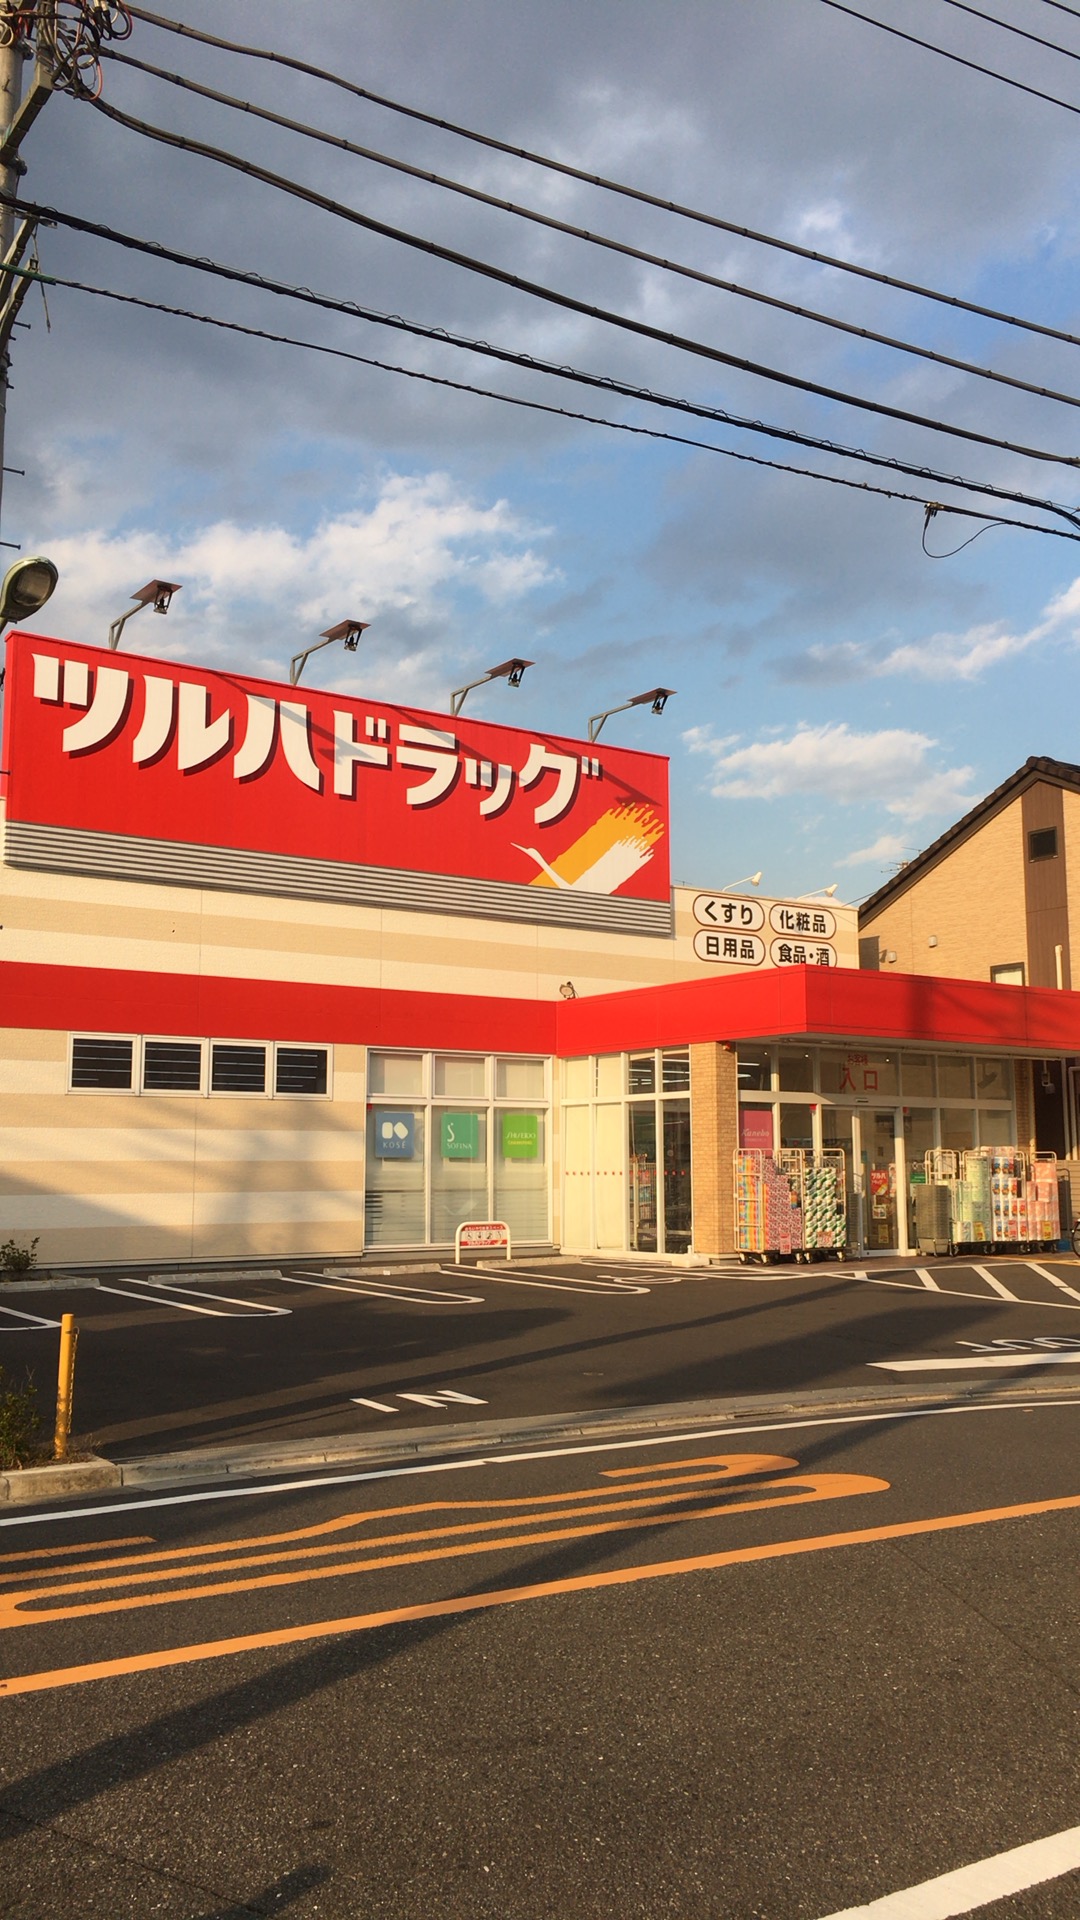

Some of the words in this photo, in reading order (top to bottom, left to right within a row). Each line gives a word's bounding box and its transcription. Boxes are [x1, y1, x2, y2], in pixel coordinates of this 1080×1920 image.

[32, 653, 600, 826] ツルハドラッグ
[704, 901, 753, 925] くすり
[779, 909, 826, 934] 化粧品
[706, 936, 754, 960] 日用品
[840, 1067, 878, 1090] 入口
[446, 1142, 472, 1150] SOFINA
[350, 1390, 489, 1412] IN
